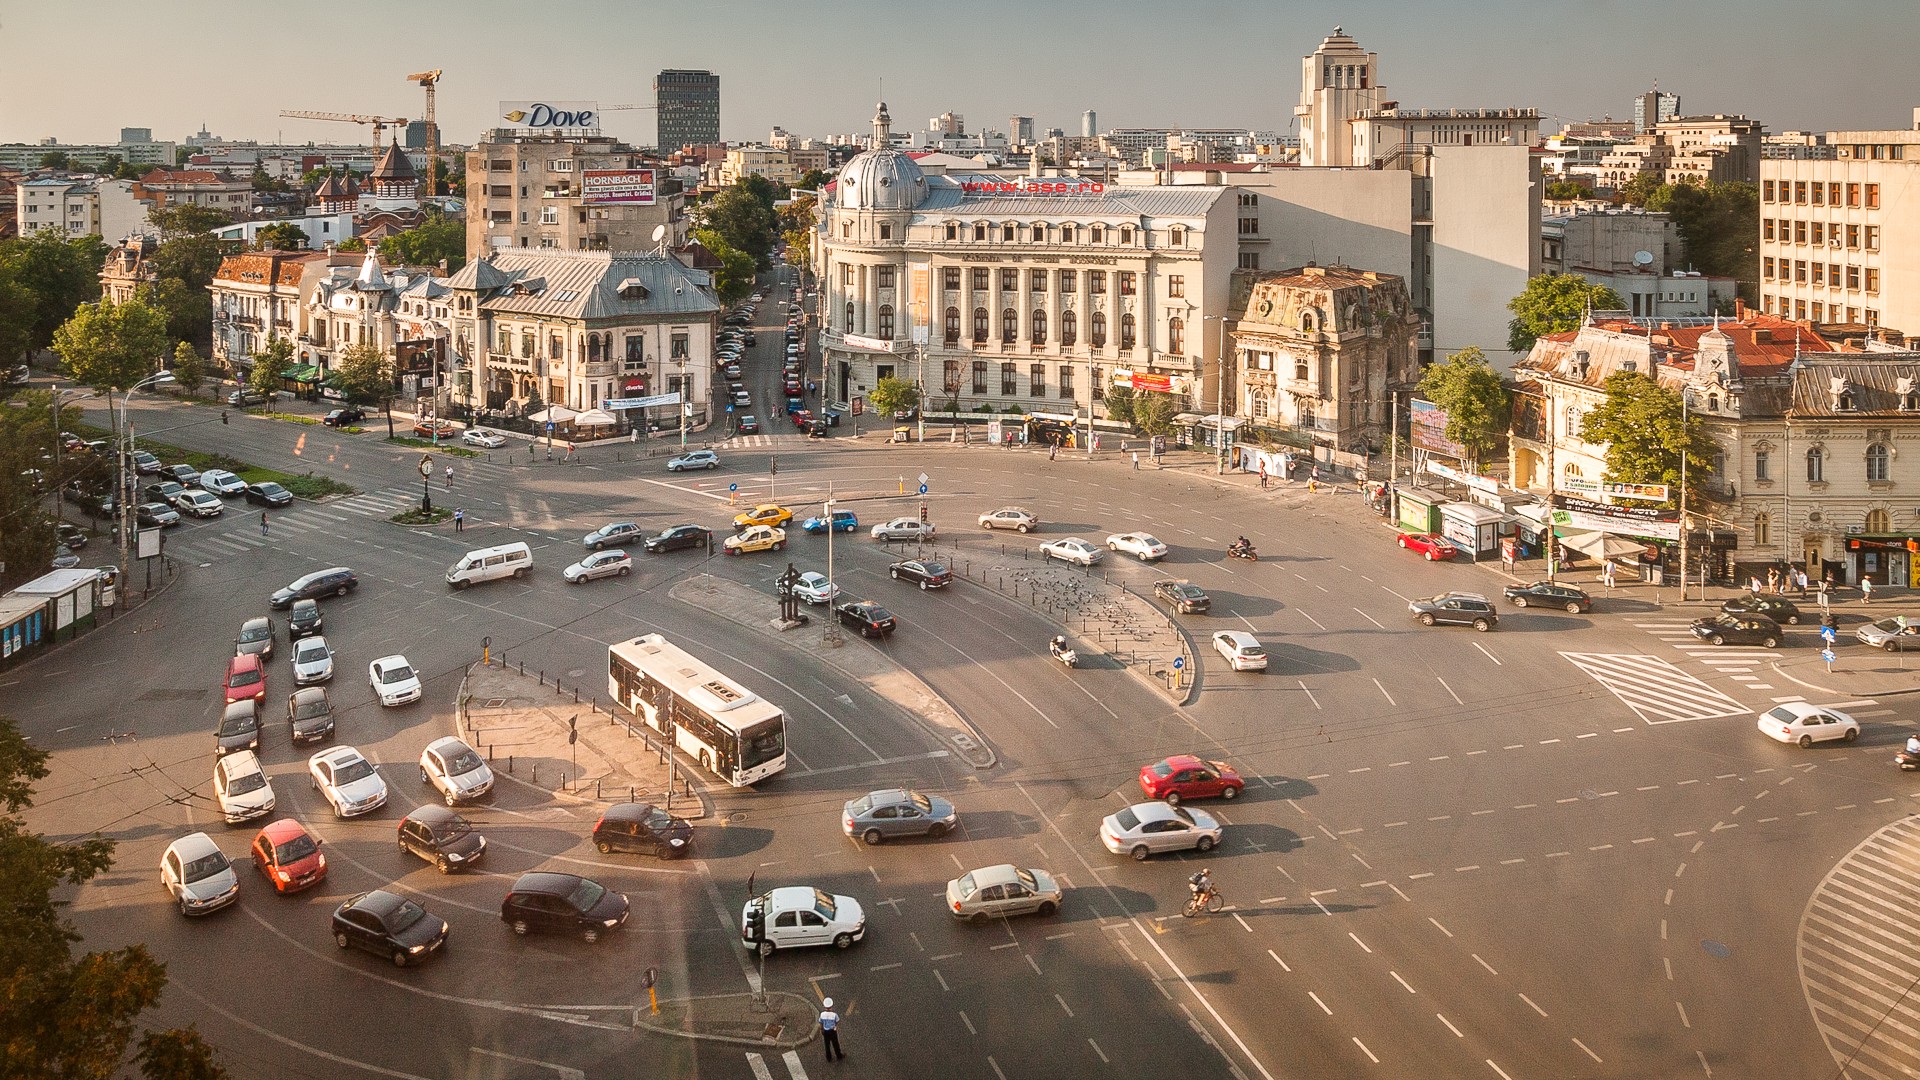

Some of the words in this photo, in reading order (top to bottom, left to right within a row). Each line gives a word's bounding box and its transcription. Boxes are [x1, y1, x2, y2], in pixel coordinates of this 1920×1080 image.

[528, 103, 593, 127] Dove
[585, 175, 641, 185] HORNBACH
[961, 181, 1104, 193] www.ase.ro
